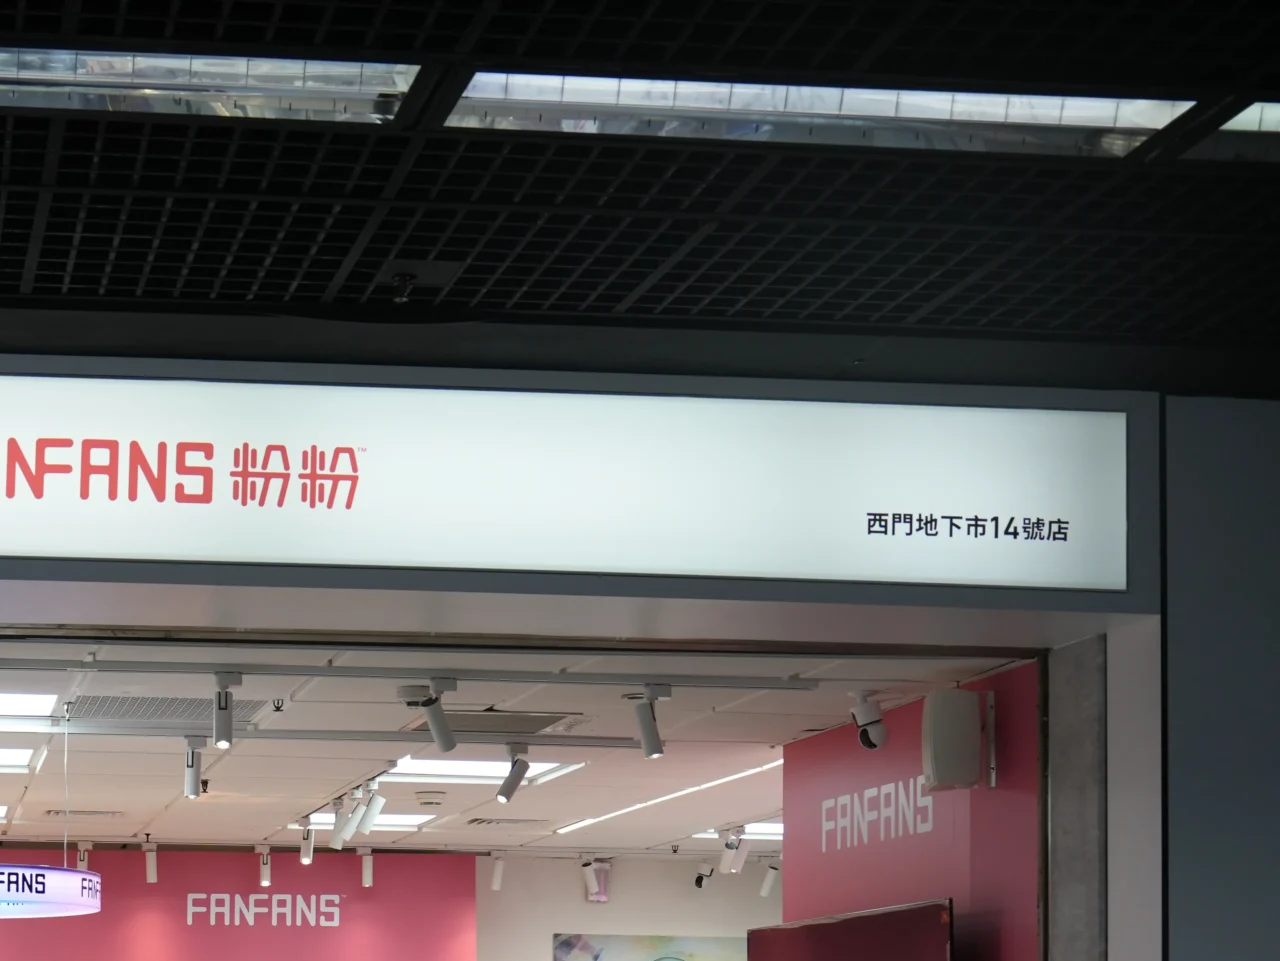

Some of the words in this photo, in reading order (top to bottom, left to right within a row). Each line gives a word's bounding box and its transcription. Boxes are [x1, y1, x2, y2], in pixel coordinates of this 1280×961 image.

[229, 442, 359, 510] 粉粉
[866, 512, 1070, 542] 西門地下市14號店
[821, 774, 933, 853] FANFANS
[186, 893, 340, 926] FANFANS
